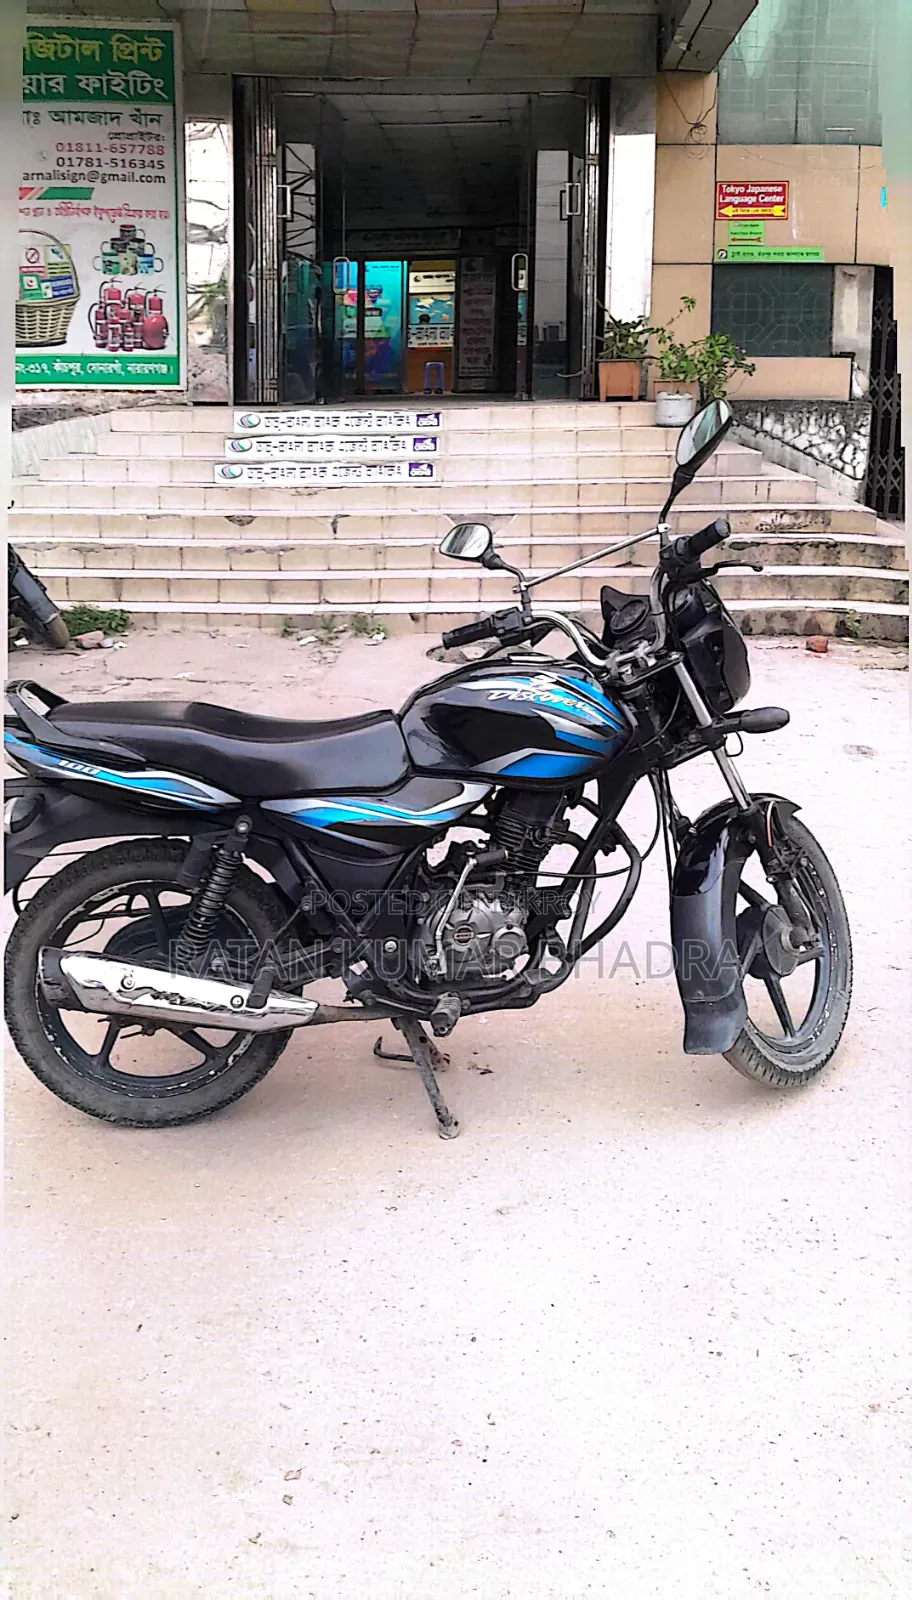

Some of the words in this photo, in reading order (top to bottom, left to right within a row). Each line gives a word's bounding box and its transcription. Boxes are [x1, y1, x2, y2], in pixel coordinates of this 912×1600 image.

[109, 33, 165, 64] প্রিন্ট
[75, 69, 168, 99] ফাইটিং
[48, 110, 123, 126] আমজাদ
[55, 142, 165, 156] 01811-657788
[56, 157, 165, 170] 01781-516345
[721, 184, 746, 195] Tokyo
[746, 184, 783, 195] Japanese
[719, 195, 758, 205] Language
[758, 194, 785, 204] Center
[58, 759, 101, 776] 100
